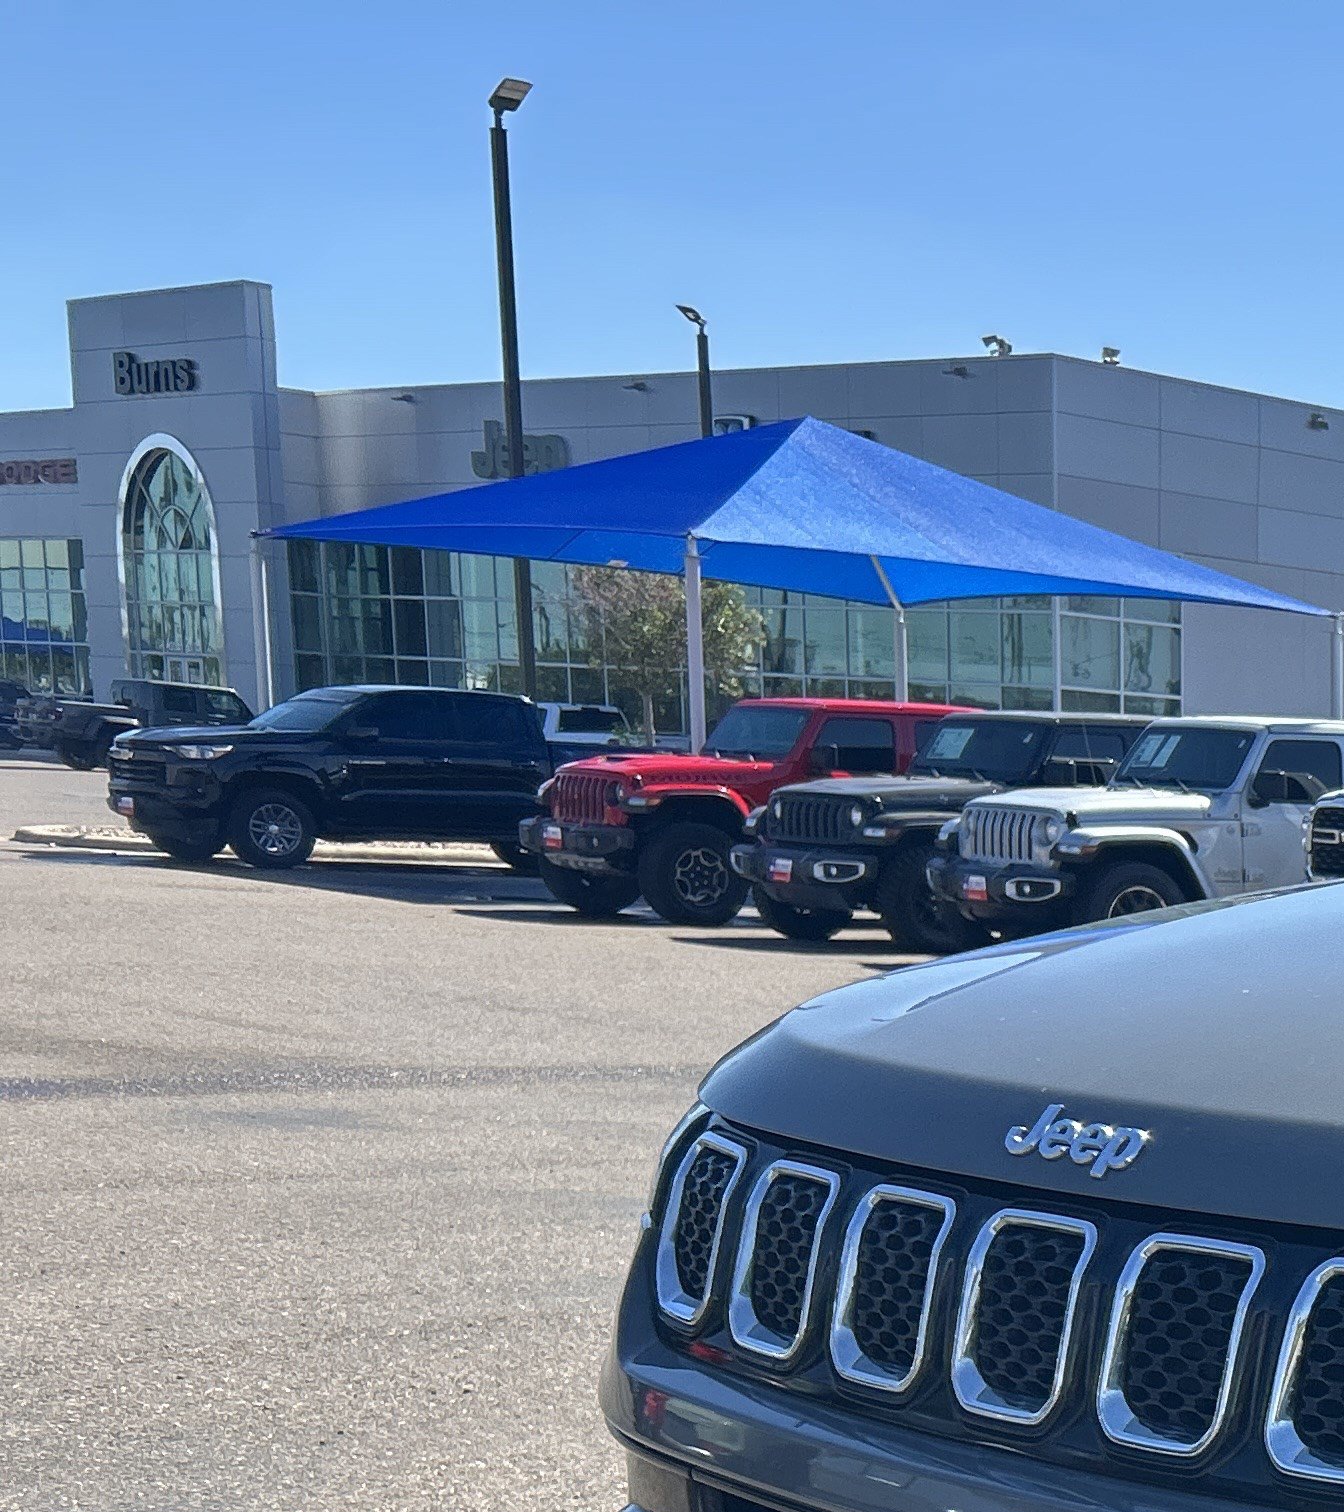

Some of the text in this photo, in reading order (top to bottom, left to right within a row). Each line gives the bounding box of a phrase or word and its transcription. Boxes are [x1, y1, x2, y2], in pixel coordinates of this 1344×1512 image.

[113, 352, 197, 395] Burns
[0, 459, 78, 486] ODGE
[1004, 1103, 1152, 1179] Jeep
